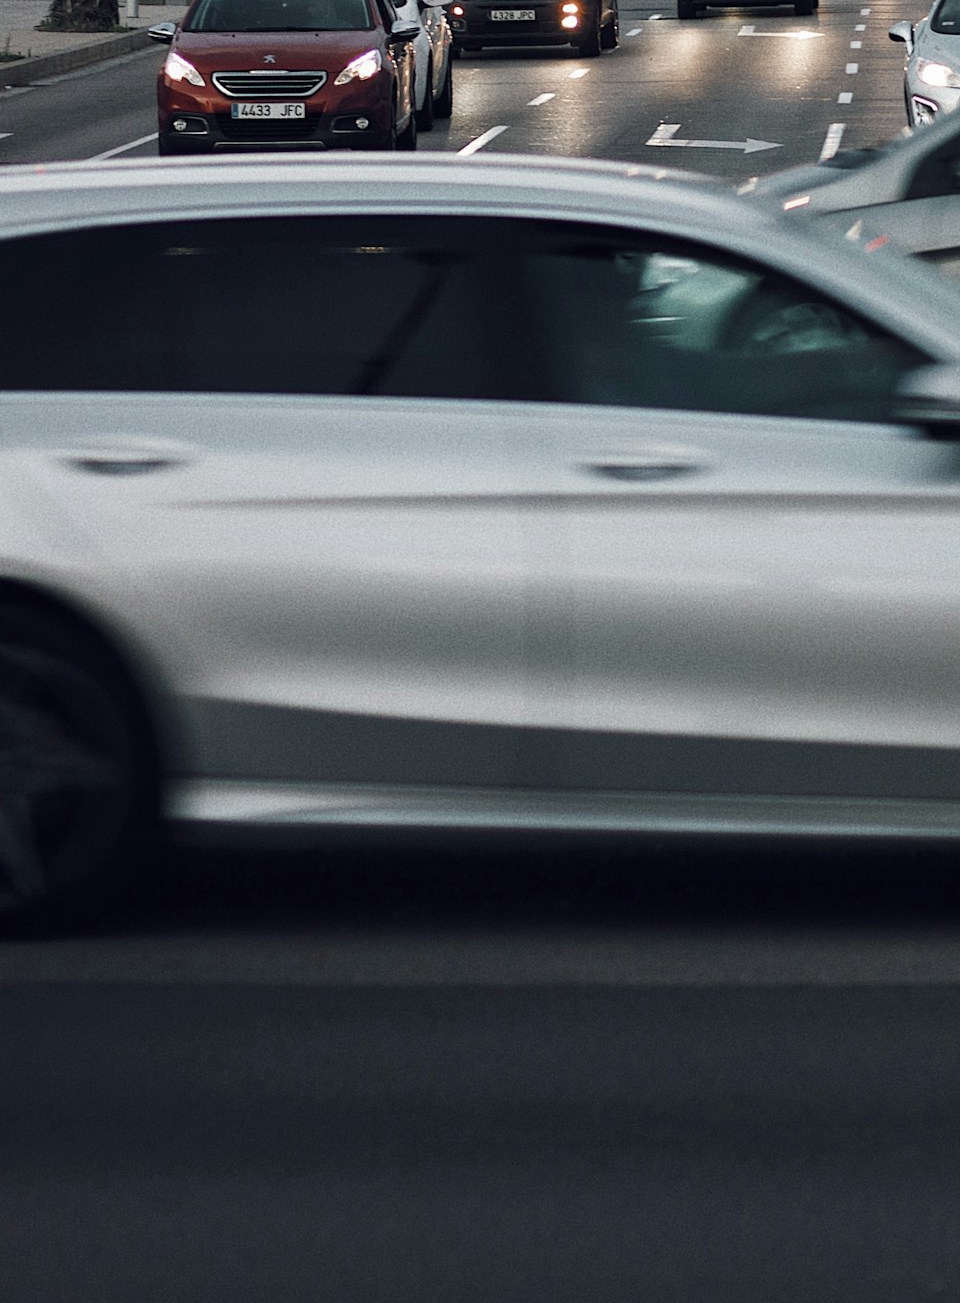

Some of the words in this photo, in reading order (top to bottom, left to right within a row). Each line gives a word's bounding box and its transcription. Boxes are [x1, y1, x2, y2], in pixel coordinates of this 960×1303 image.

[492, 11, 515, 20] 4328
[516, 11, 534, 20] JPC
[241, 104, 272, 117] 4433
[280, 104, 303, 117] JFC
